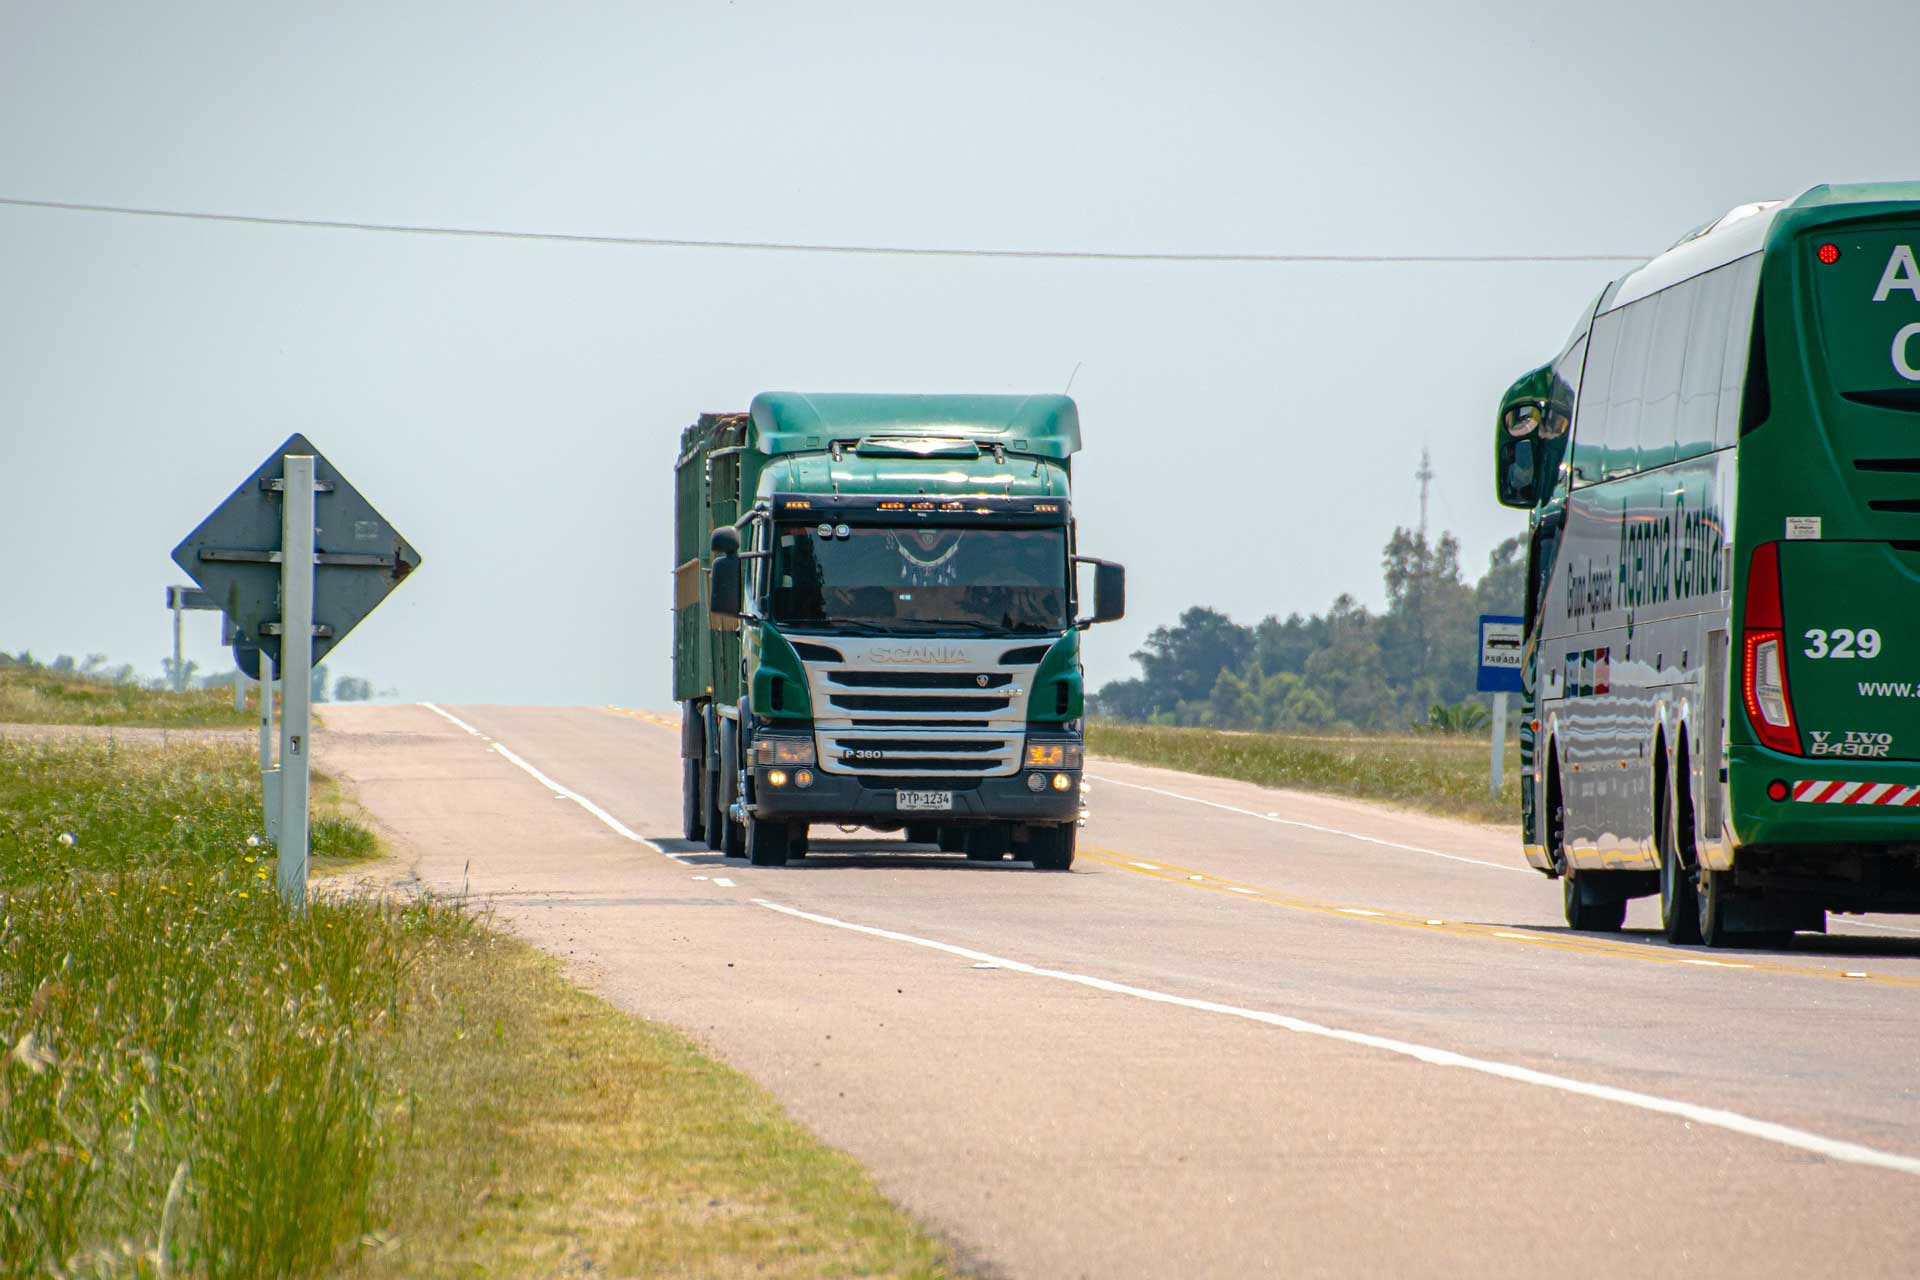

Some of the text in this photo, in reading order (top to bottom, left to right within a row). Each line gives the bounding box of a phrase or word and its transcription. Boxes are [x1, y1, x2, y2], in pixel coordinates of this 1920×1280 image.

[1872, 245, 1920, 301] A
[1617, 473, 1726, 640] Agencia Central
[1804, 628, 1882, 659] 329
[868, 647, 974, 663] SCANIA
[1809, 731, 1893, 744] VLVO
[856, 750, 882, 759] 360
[1811, 742, 1890, 757] B430R
